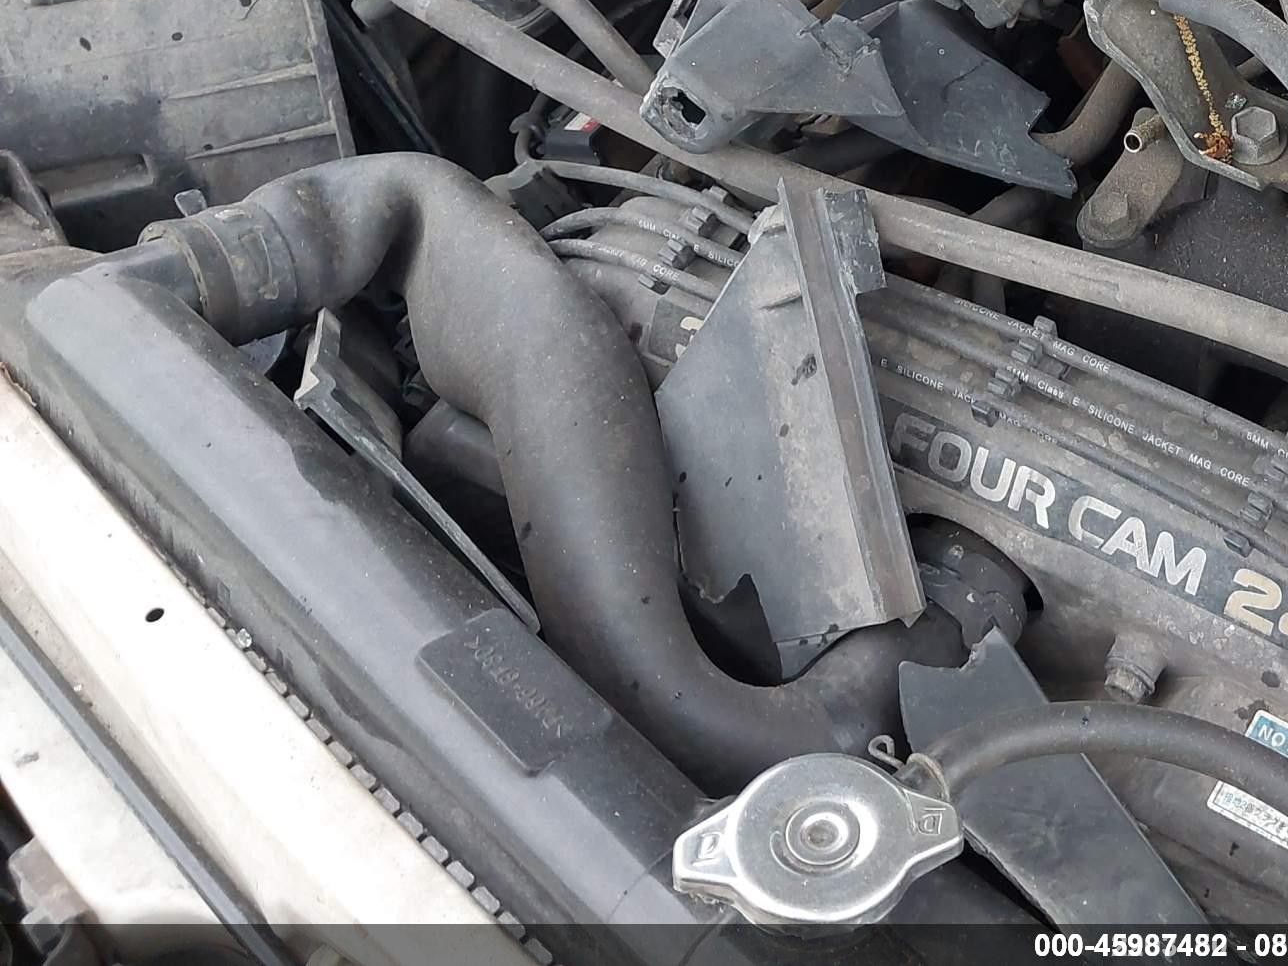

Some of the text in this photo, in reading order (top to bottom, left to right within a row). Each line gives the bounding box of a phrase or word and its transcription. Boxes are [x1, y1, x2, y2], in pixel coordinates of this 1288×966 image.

[880, 357, 889, 368] E
[897, 365, 944, 391] SILICONE
[1053, 341, 1075, 356] MAG
[1082, 354, 1111, 374] CORE
[1037, 380, 1064, 400] Class
[1072, 396, 1081, 407] E
[1088, 404, 1135, 434] SILICONE
[1142, 433, 1182, 456] JACKET
[1188, 453, 1212, 471] MAG
[1219, 466, 1251, 487] CORE
[891, 412, 1056, 529] FOUR
[1068, 495, 1207, 596] CAM
